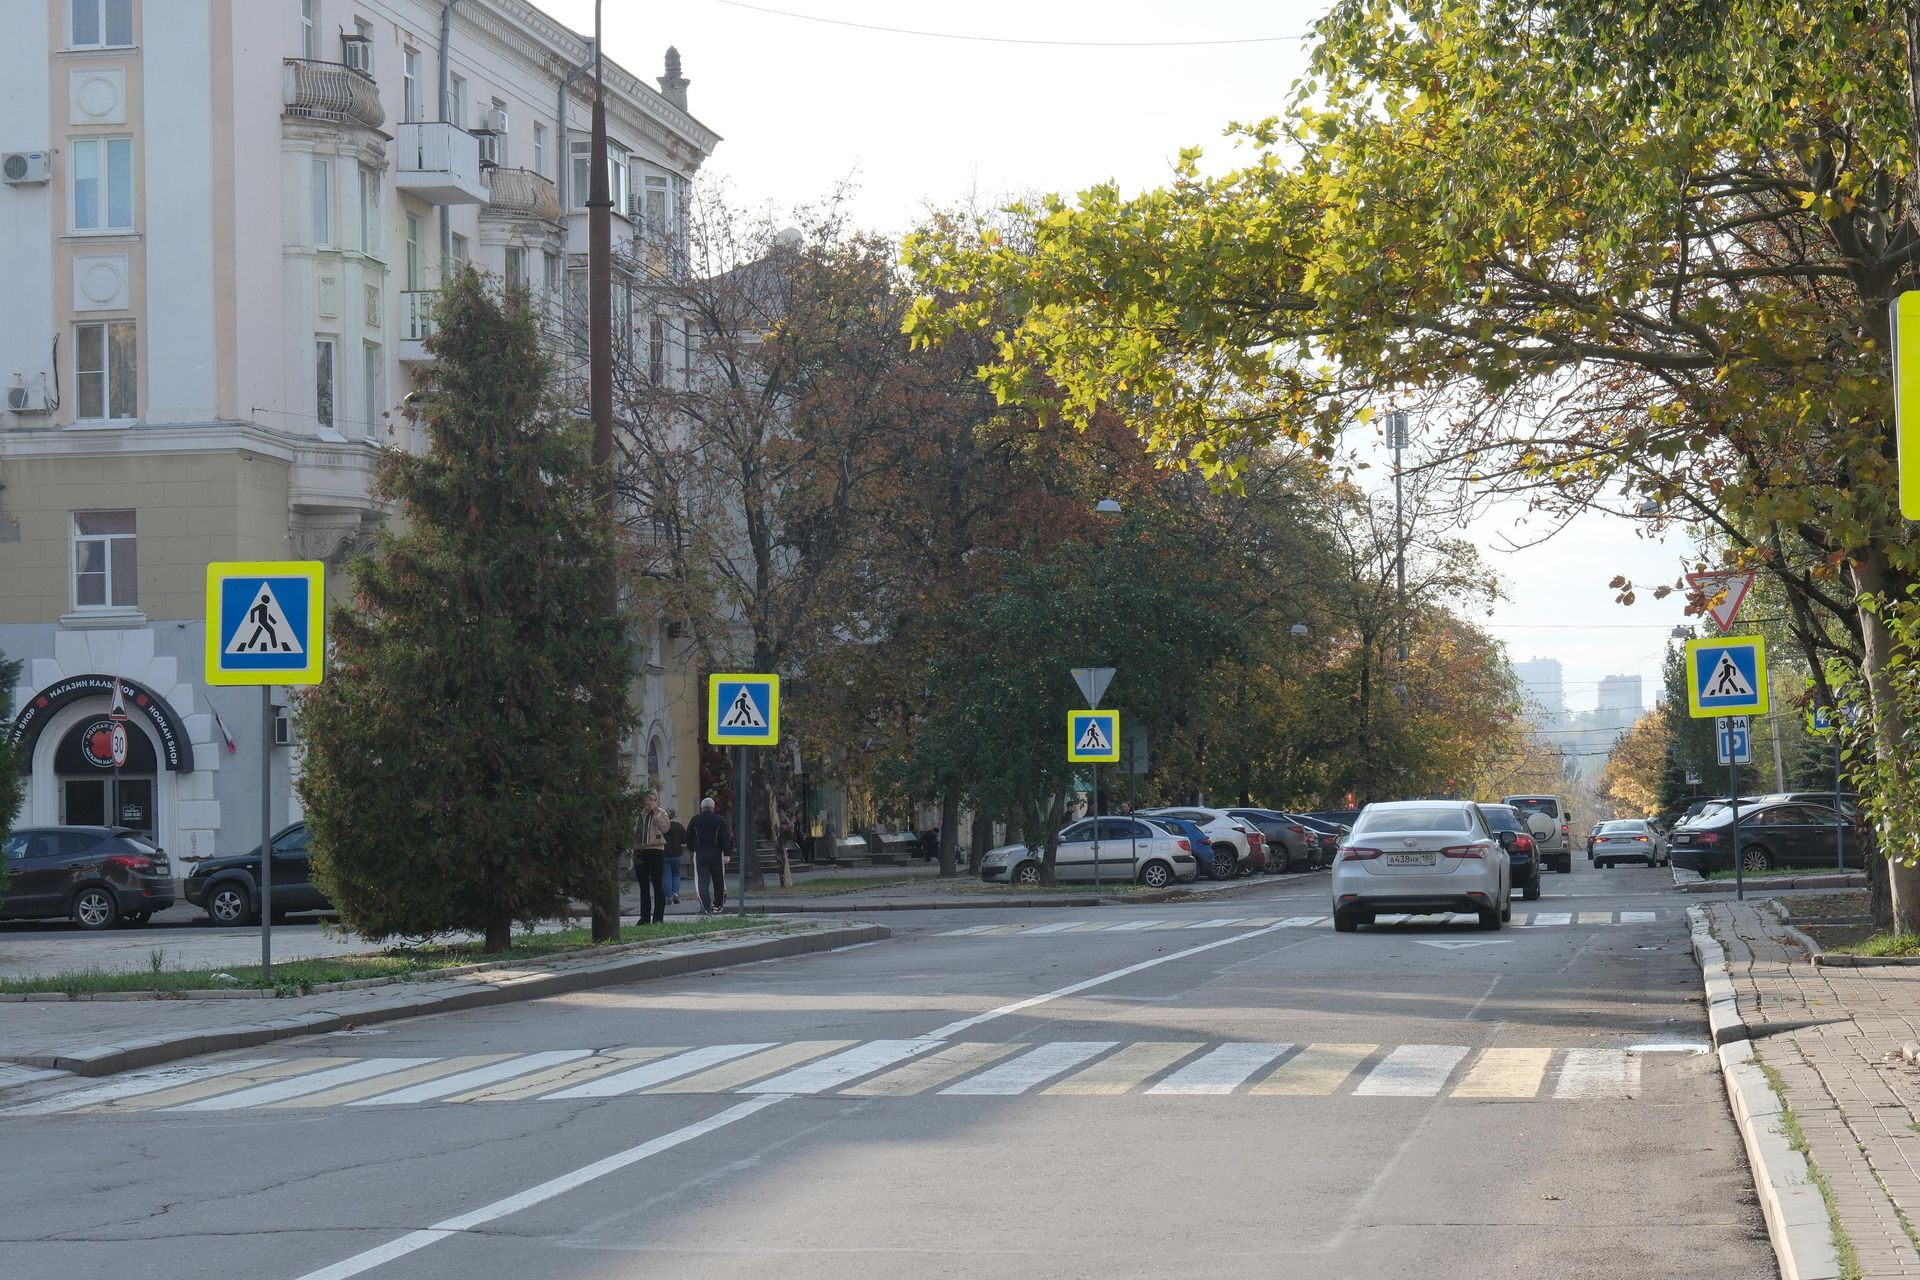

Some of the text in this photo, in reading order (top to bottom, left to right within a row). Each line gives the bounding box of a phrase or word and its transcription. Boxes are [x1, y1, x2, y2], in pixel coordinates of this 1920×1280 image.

[49, 680, 88, 699] МАГАЗИН
[19, 708, 35, 729] SHOP
[114, 735, 124, 754] 30
[148, 705, 178, 765] HOOKAH SHOP
